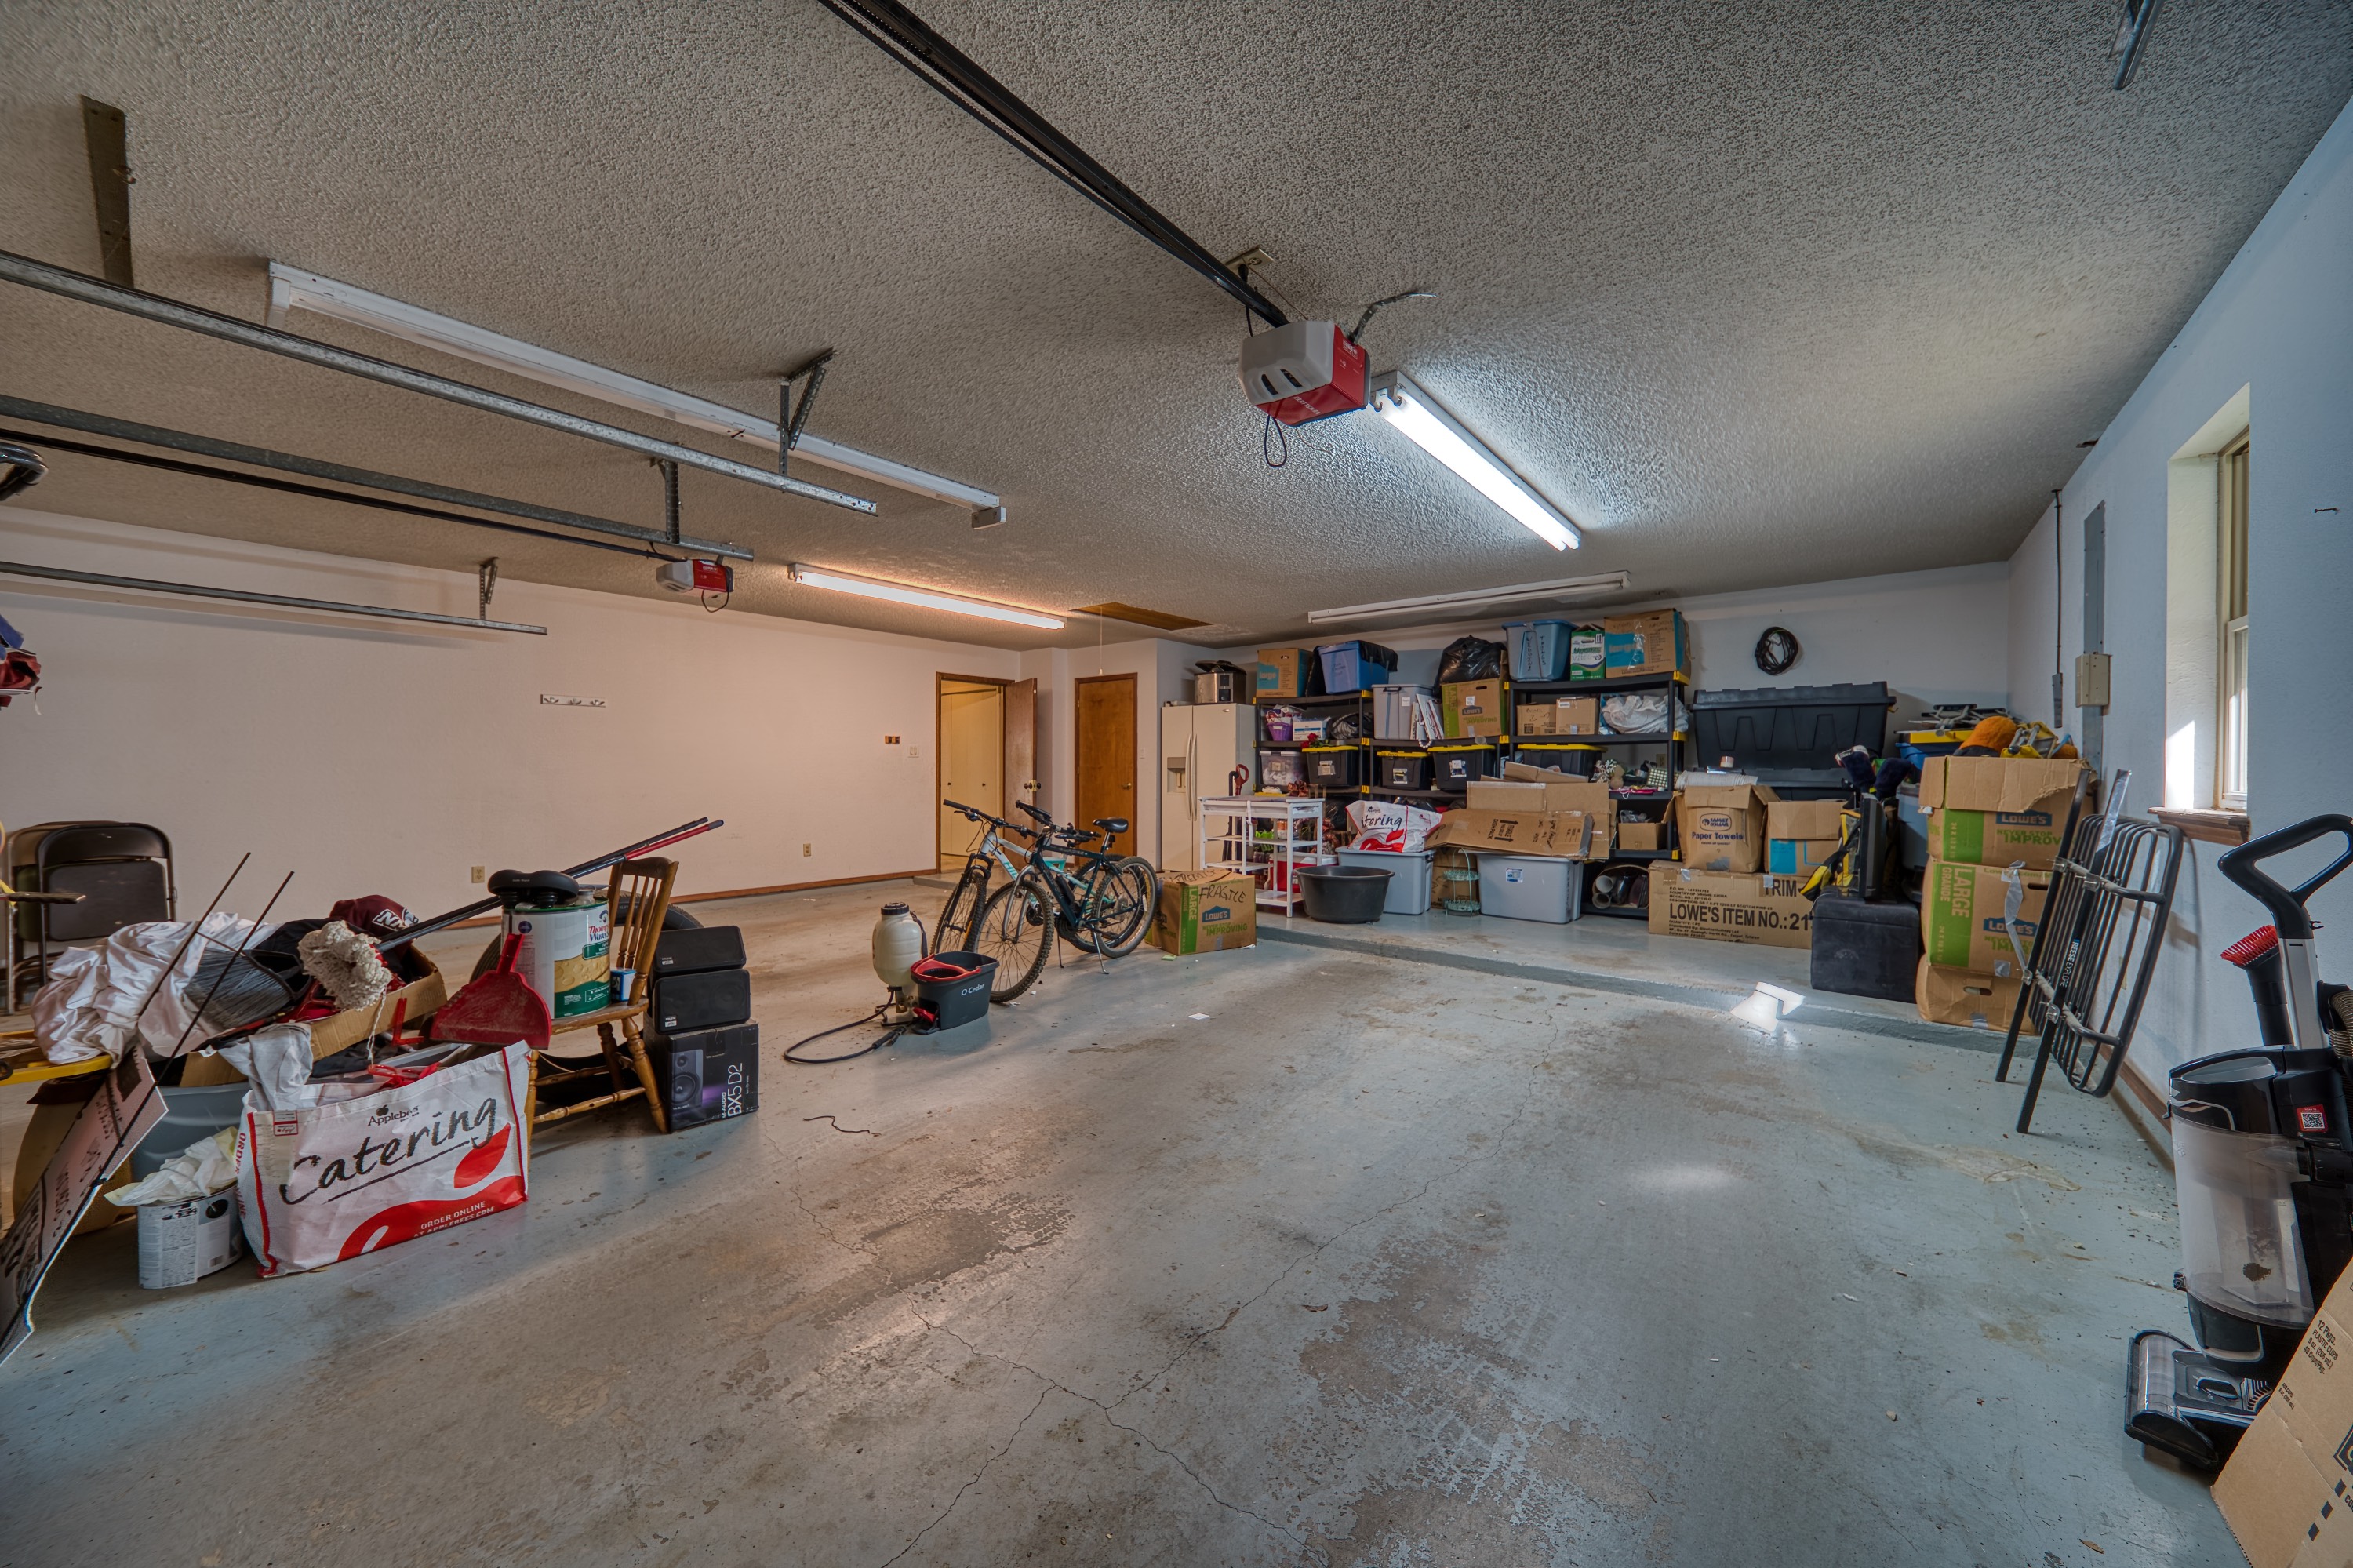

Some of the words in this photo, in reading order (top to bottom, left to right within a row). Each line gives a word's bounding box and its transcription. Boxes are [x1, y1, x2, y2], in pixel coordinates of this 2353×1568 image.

[2002, 814, 2047, 824] LOWE'S
[1692, 831, 1712, 841] Paper
[1940, 867, 1951, 902] GRANDE
[1952, 868, 1973, 918] LARGE
[1205, 910, 1228, 921] LOWE'S
[1669, 903, 1719, 924] LOWE'S
[1722, 908, 1755, 926] ITEM
[1789, 913, 1813, 931] 21
[1989, 921, 2034, 935] LOE'S
[1206, 924, 1247, 937] IMPROVING
[2068, 941, 2079, 962] REESE
[728, 1063, 743, 1085] D2
[728, 1086, 743, 1119] BX5
[278, 1097, 497, 1206] Catering
[420, 1213, 452, 1231] ORDER
[453, 1201, 486, 1218] ONLINE
[2312, 1329, 2328, 1349] PLASTIC
[2326, 1346, 2339, 1360] CUPS
[2318, 1319, 2326, 1331] 12
[2323, 1326, 2336, 1346] Pkgs.
[2304, 1346, 2310, 1355] 40
[2308, 1351, 2325, 1374] Cups/Pkg.
[2325, 1359, 2333, 1370] mL)
